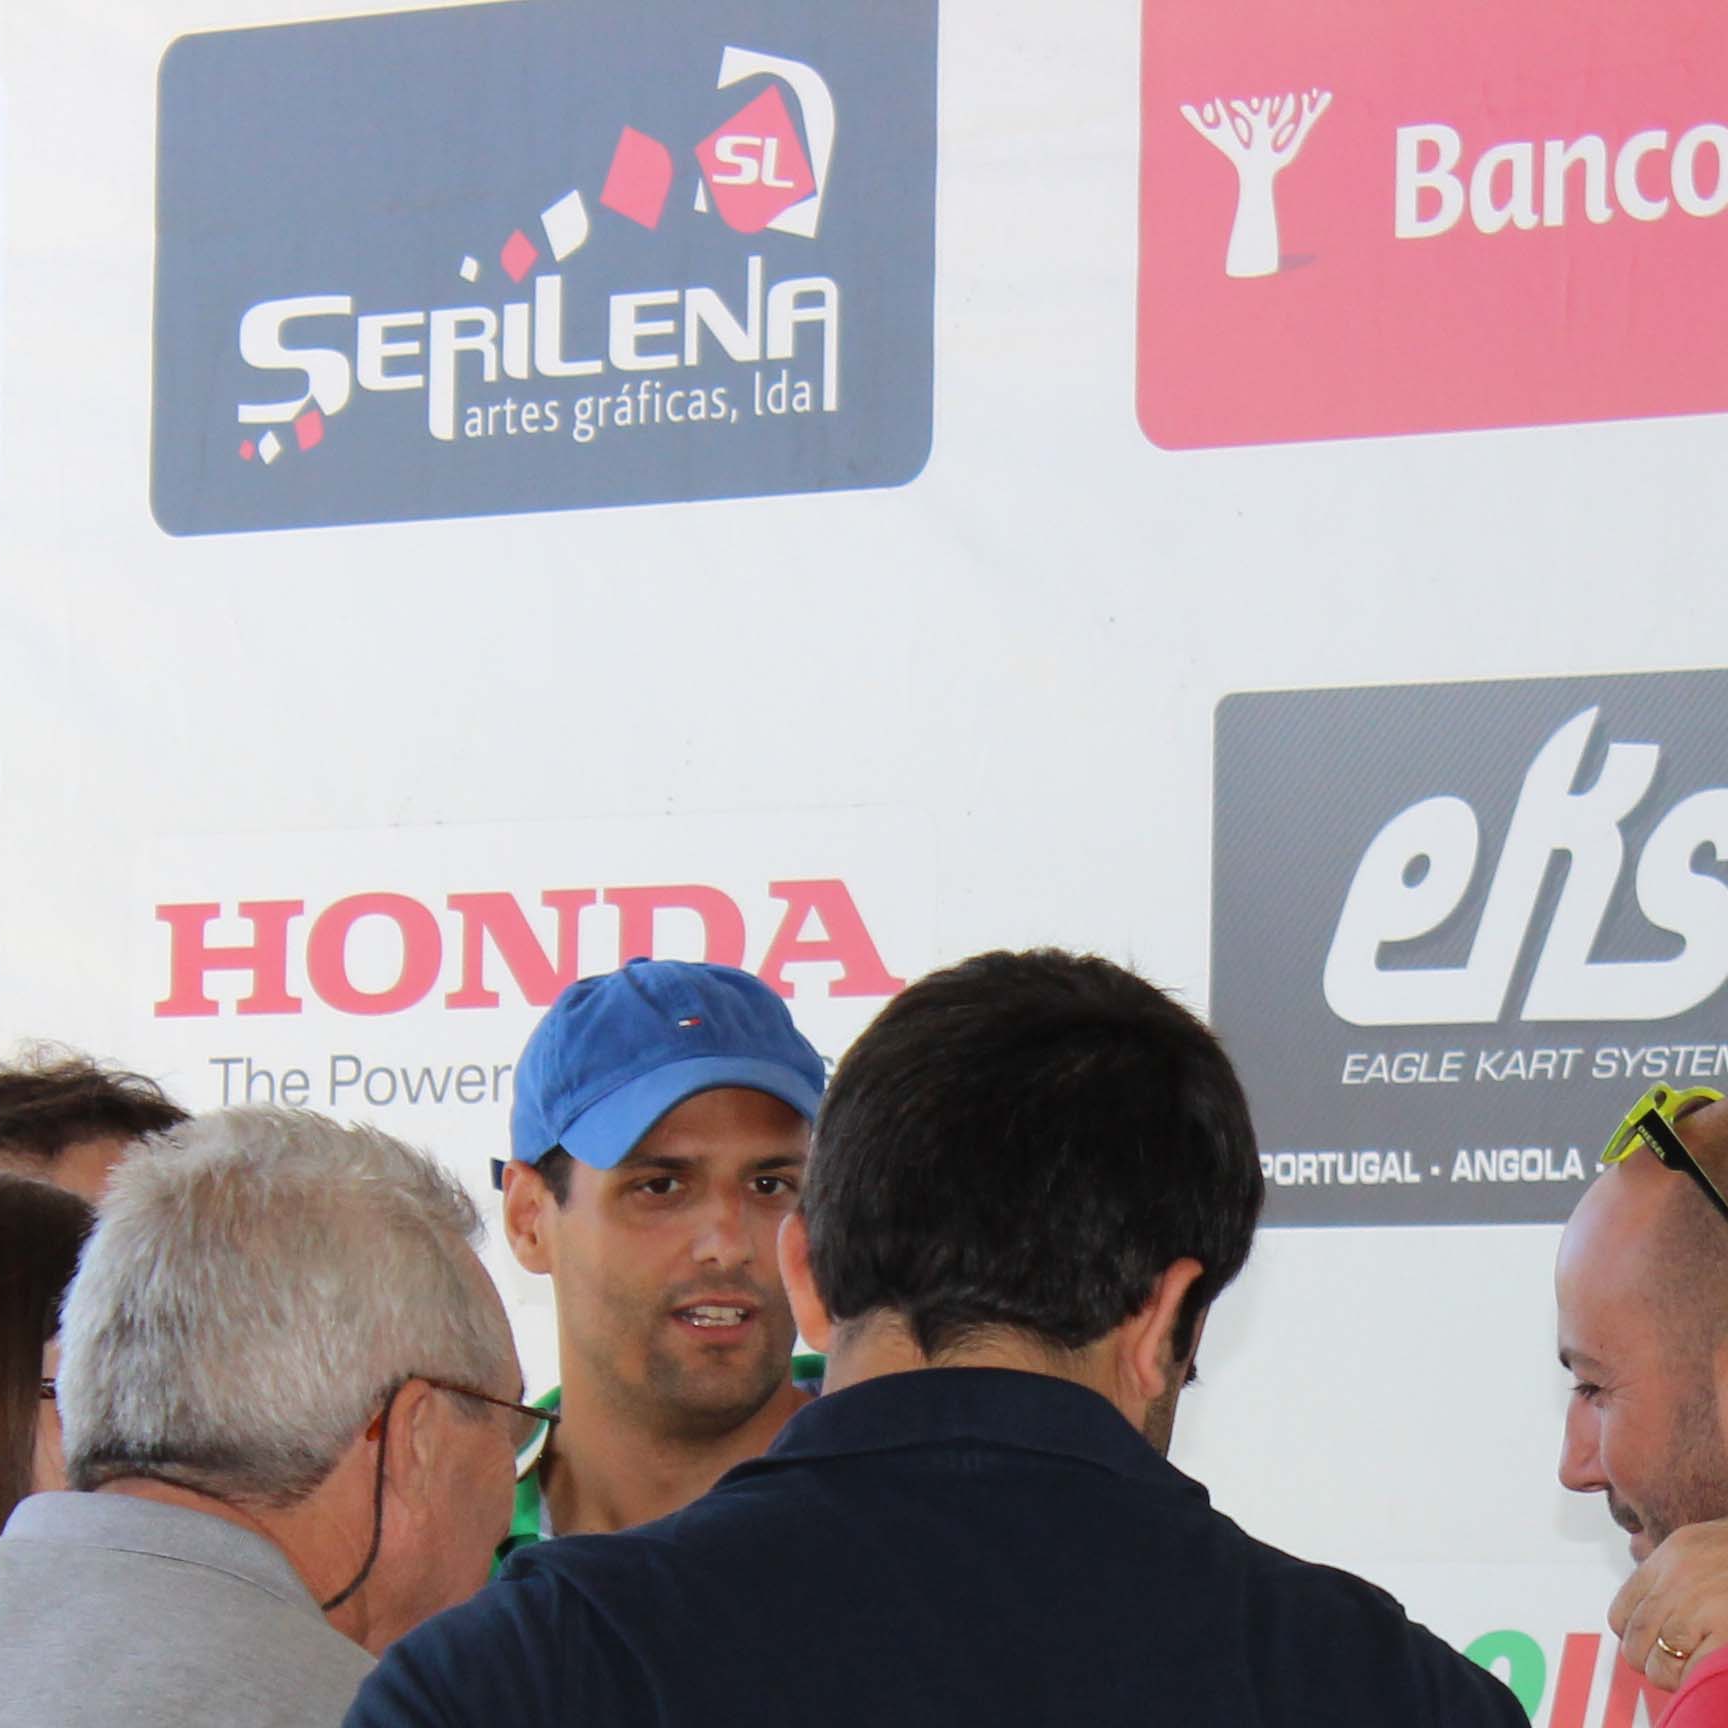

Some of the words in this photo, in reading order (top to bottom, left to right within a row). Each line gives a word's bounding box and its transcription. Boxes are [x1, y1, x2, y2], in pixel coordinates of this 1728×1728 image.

[712, 135, 795, 189] SL
[465, 396, 559, 437] artes
[574, 381, 738, 439] gráficas,
[754, 370, 812, 416] lda
[154, 878, 906, 1018] HONDA
[208, 1057, 310, 1107] The
[329, 1054, 512, 1106] Power
[1341, 1050, 1466, 1085] EAGLE
[1475, 1048, 1584, 1081] KART
[1450, 1148, 1585, 1183] ANGOLA
